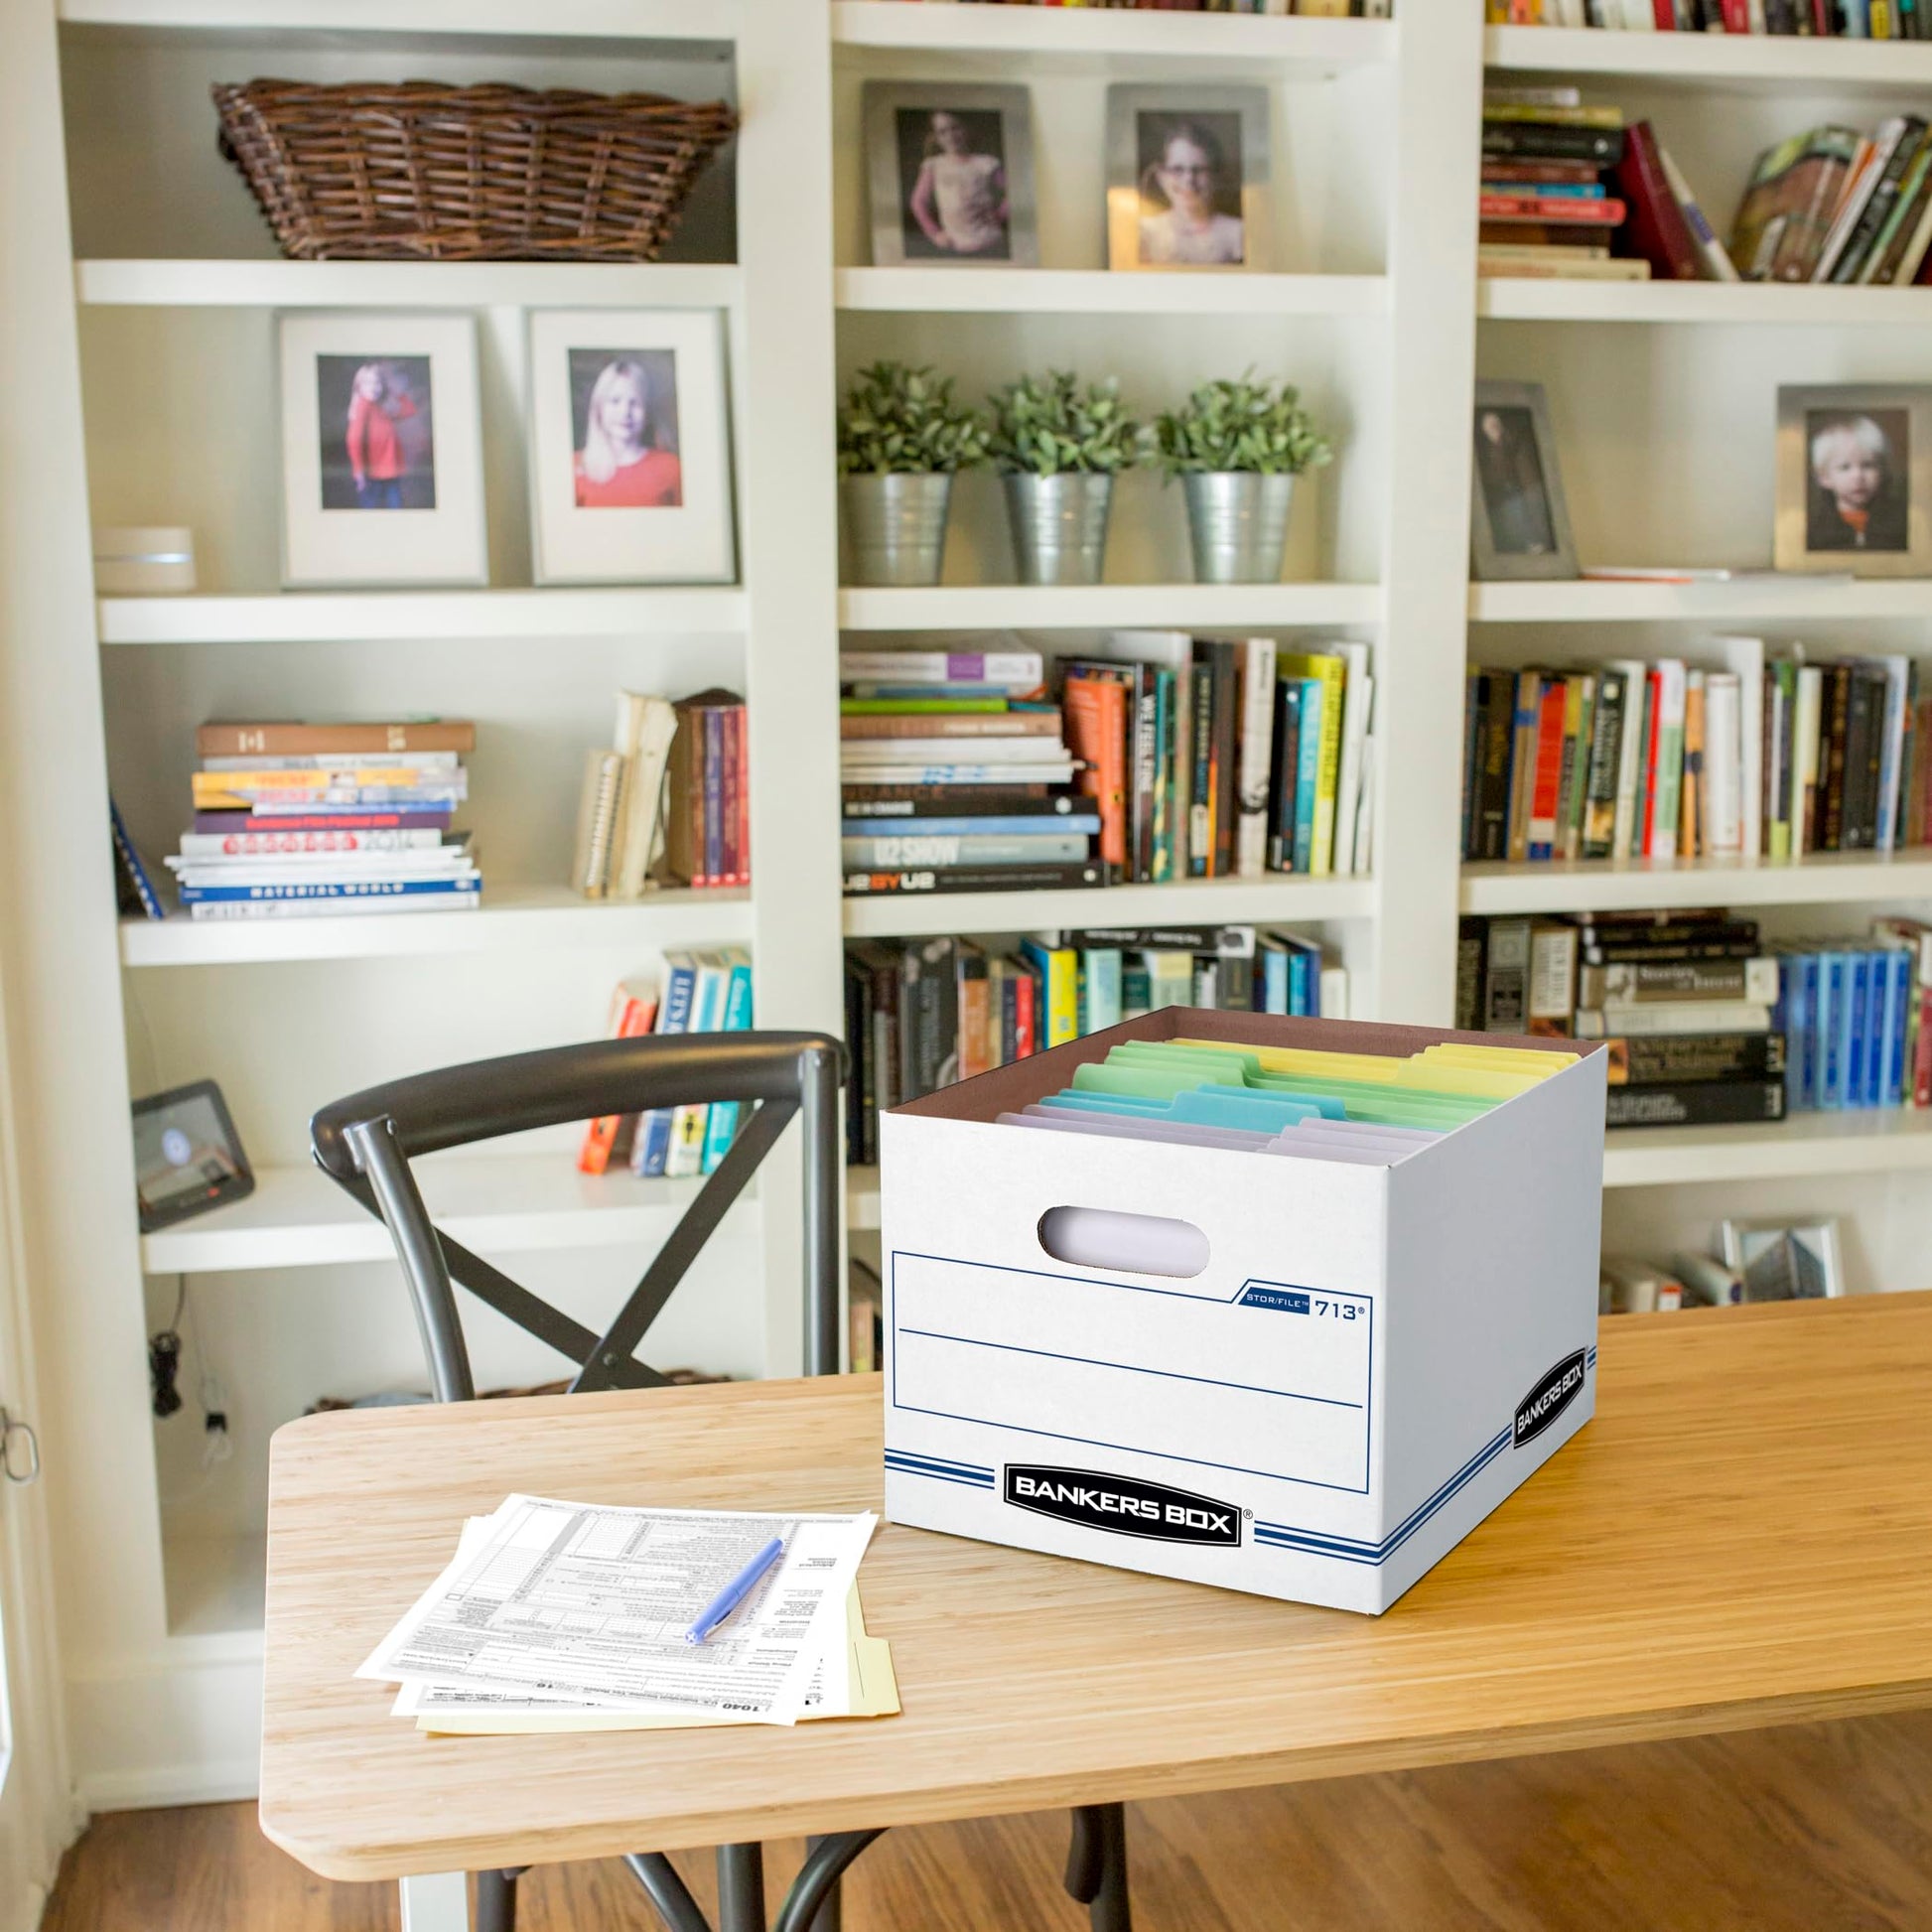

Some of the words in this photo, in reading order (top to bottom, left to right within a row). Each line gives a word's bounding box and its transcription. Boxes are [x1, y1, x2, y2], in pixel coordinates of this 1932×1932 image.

[250, 885, 339, 898] MATERIAL
[344, 882, 405, 895] WORLD
[1314, 1300, 1356, 1320] 713
[1517, 1380, 1562, 1436] BANKERS
[1562, 1360, 1583, 1394] BOX
[1016, 1475, 1161, 1520] BANKERS
[1165, 1504, 1232, 1535] BOX
[723, 1703, 760, 1713] 1040
